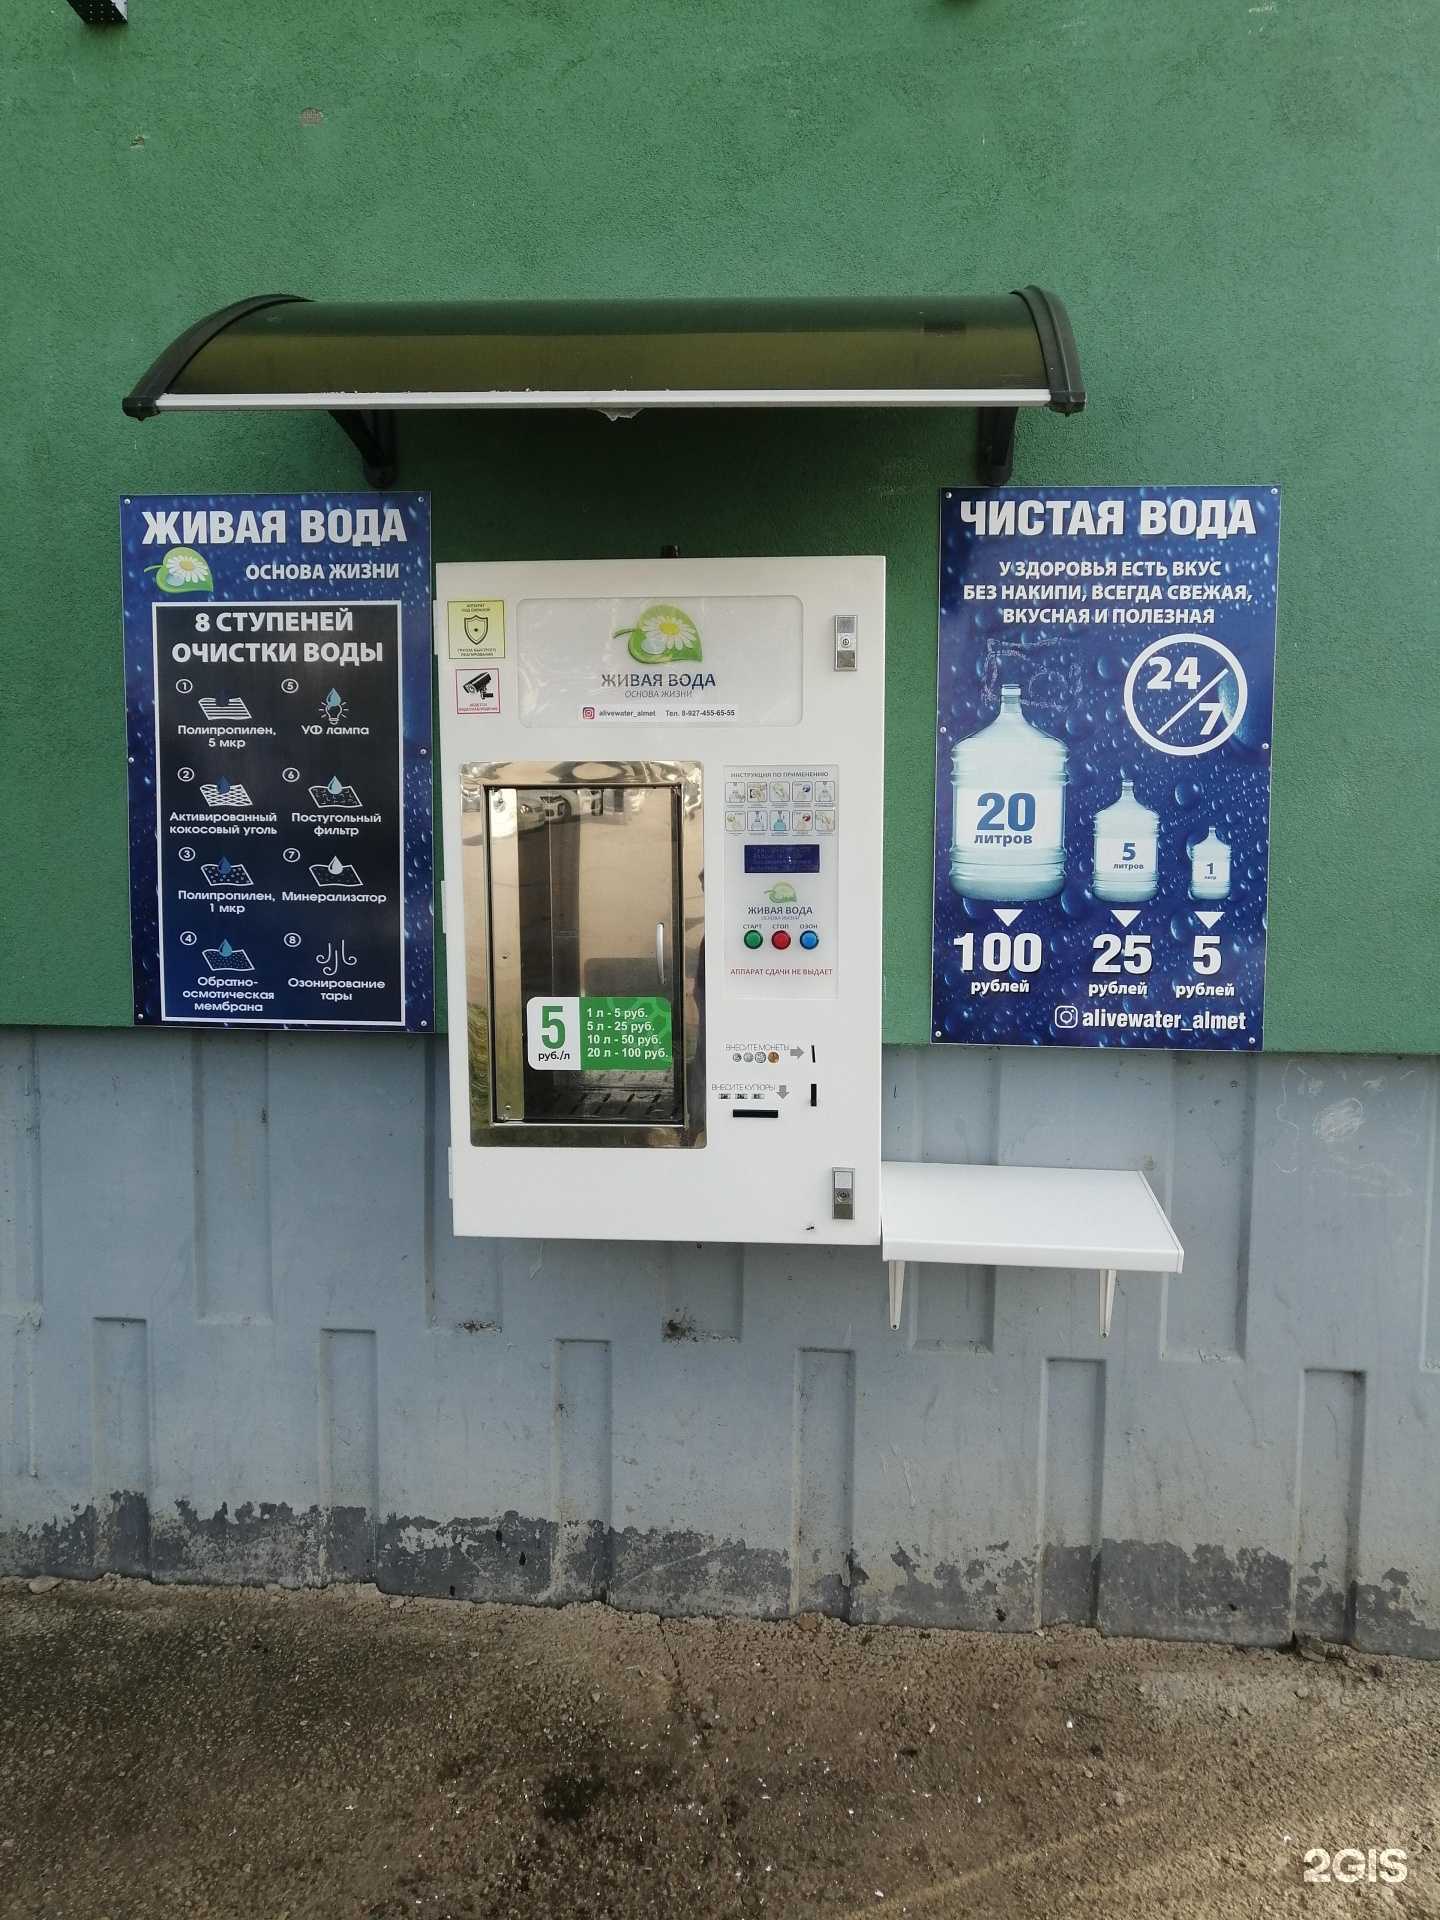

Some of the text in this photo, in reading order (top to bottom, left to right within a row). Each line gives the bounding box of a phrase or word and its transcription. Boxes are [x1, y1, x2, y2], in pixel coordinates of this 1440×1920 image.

[960, 499, 1256, 539] ЧИСТАЯ ВОДА
[142, 508, 407, 547] ЖИВАЯ ВОДА
[245, 563, 399, 581] ОСНОВА ЖИЗНИ
[1121, 561, 1167, 576] ЕСТЬ
[1172, 561, 1222, 576] ВКУС
[963, 585, 1252, 603] БЕЗ НАКИПИ, ВСЕГДА СВЕЖАЯ,
[195, 608, 353, 632] 8 СТУПЕНЕЙ
[1003, 608, 1215, 624] ВКУСНАЯ И ПОЛЕЗНАЯ
[172, 642, 383, 666] ОЧИСТКИ ВОДЫ
[601, 673, 716, 690] ЖИВАЯ ВОДА
[624, 690, 692, 698] ОСНОВА ЖИЗНИ
[178, 725, 276, 736] Полипропилен,
[301, 725, 369, 736] УФ лампа
[208, 738, 245, 750] 5 мкр
[169, 812, 277, 823] Активированный
[976, 792, 1036, 832] 20
[291, 812, 382, 825] Постугольный
[169, 825, 277, 837] кокосовый уголь
[313, 825, 359, 837] фильтр
[974, 833, 1033, 847] литров
[1122, 843, 1136, 862] 5
[1113, 863, 1144, 871] литров
[1206, 862, 1213, 875] 1
[178, 890, 276, 902] Полипропилен,
[282, 892, 387, 904] Минерализатор
[209, 904, 246, 914] 1 мкр
[747, 906, 813, 916] ЖИВАЯ ВОДА
[953, 932, 1042, 973] 100
[1092, 933, 1153, 974] 25
[1192, 936, 1222, 975] 5
[197, 976, 258, 988] Обратно-
[288, 978, 385, 990] Озонирование
[971, 979, 1030, 995] рублей
[183, 990, 274, 1000] осмотическая
[1088, 982, 1148, 997] рублей
[1175, 983, 1235, 999] рублей
[320, 992, 352, 1002] тары
[194, 1002, 263, 1012] мембрана
[587, 1008, 592, 1017] 1
[614, 1008, 621, 1017] 5
[624, 1008, 648, 1020] руб.
[1082, 1008, 1247, 1031] alivewater_almet
[542, 1006, 566, 1049] 5
[587, 1022, 593, 1031] 5
[614, 1022, 627, 1031] 25
[631, 1022, 655, 1033] руб.
[587, 1035, 600, 1044] 10
[603, 1036, 611, 1044] л
[621, 1035, 635, 1044] 50
[637, 1035, 662, 1046] руб.
[538, 1051, 571, 1061] руб./л
[587, 1048, 600, 1057] 20
[622, 1048, 641, 1057] 100
[644, 1048, 668, 1059] руб.
